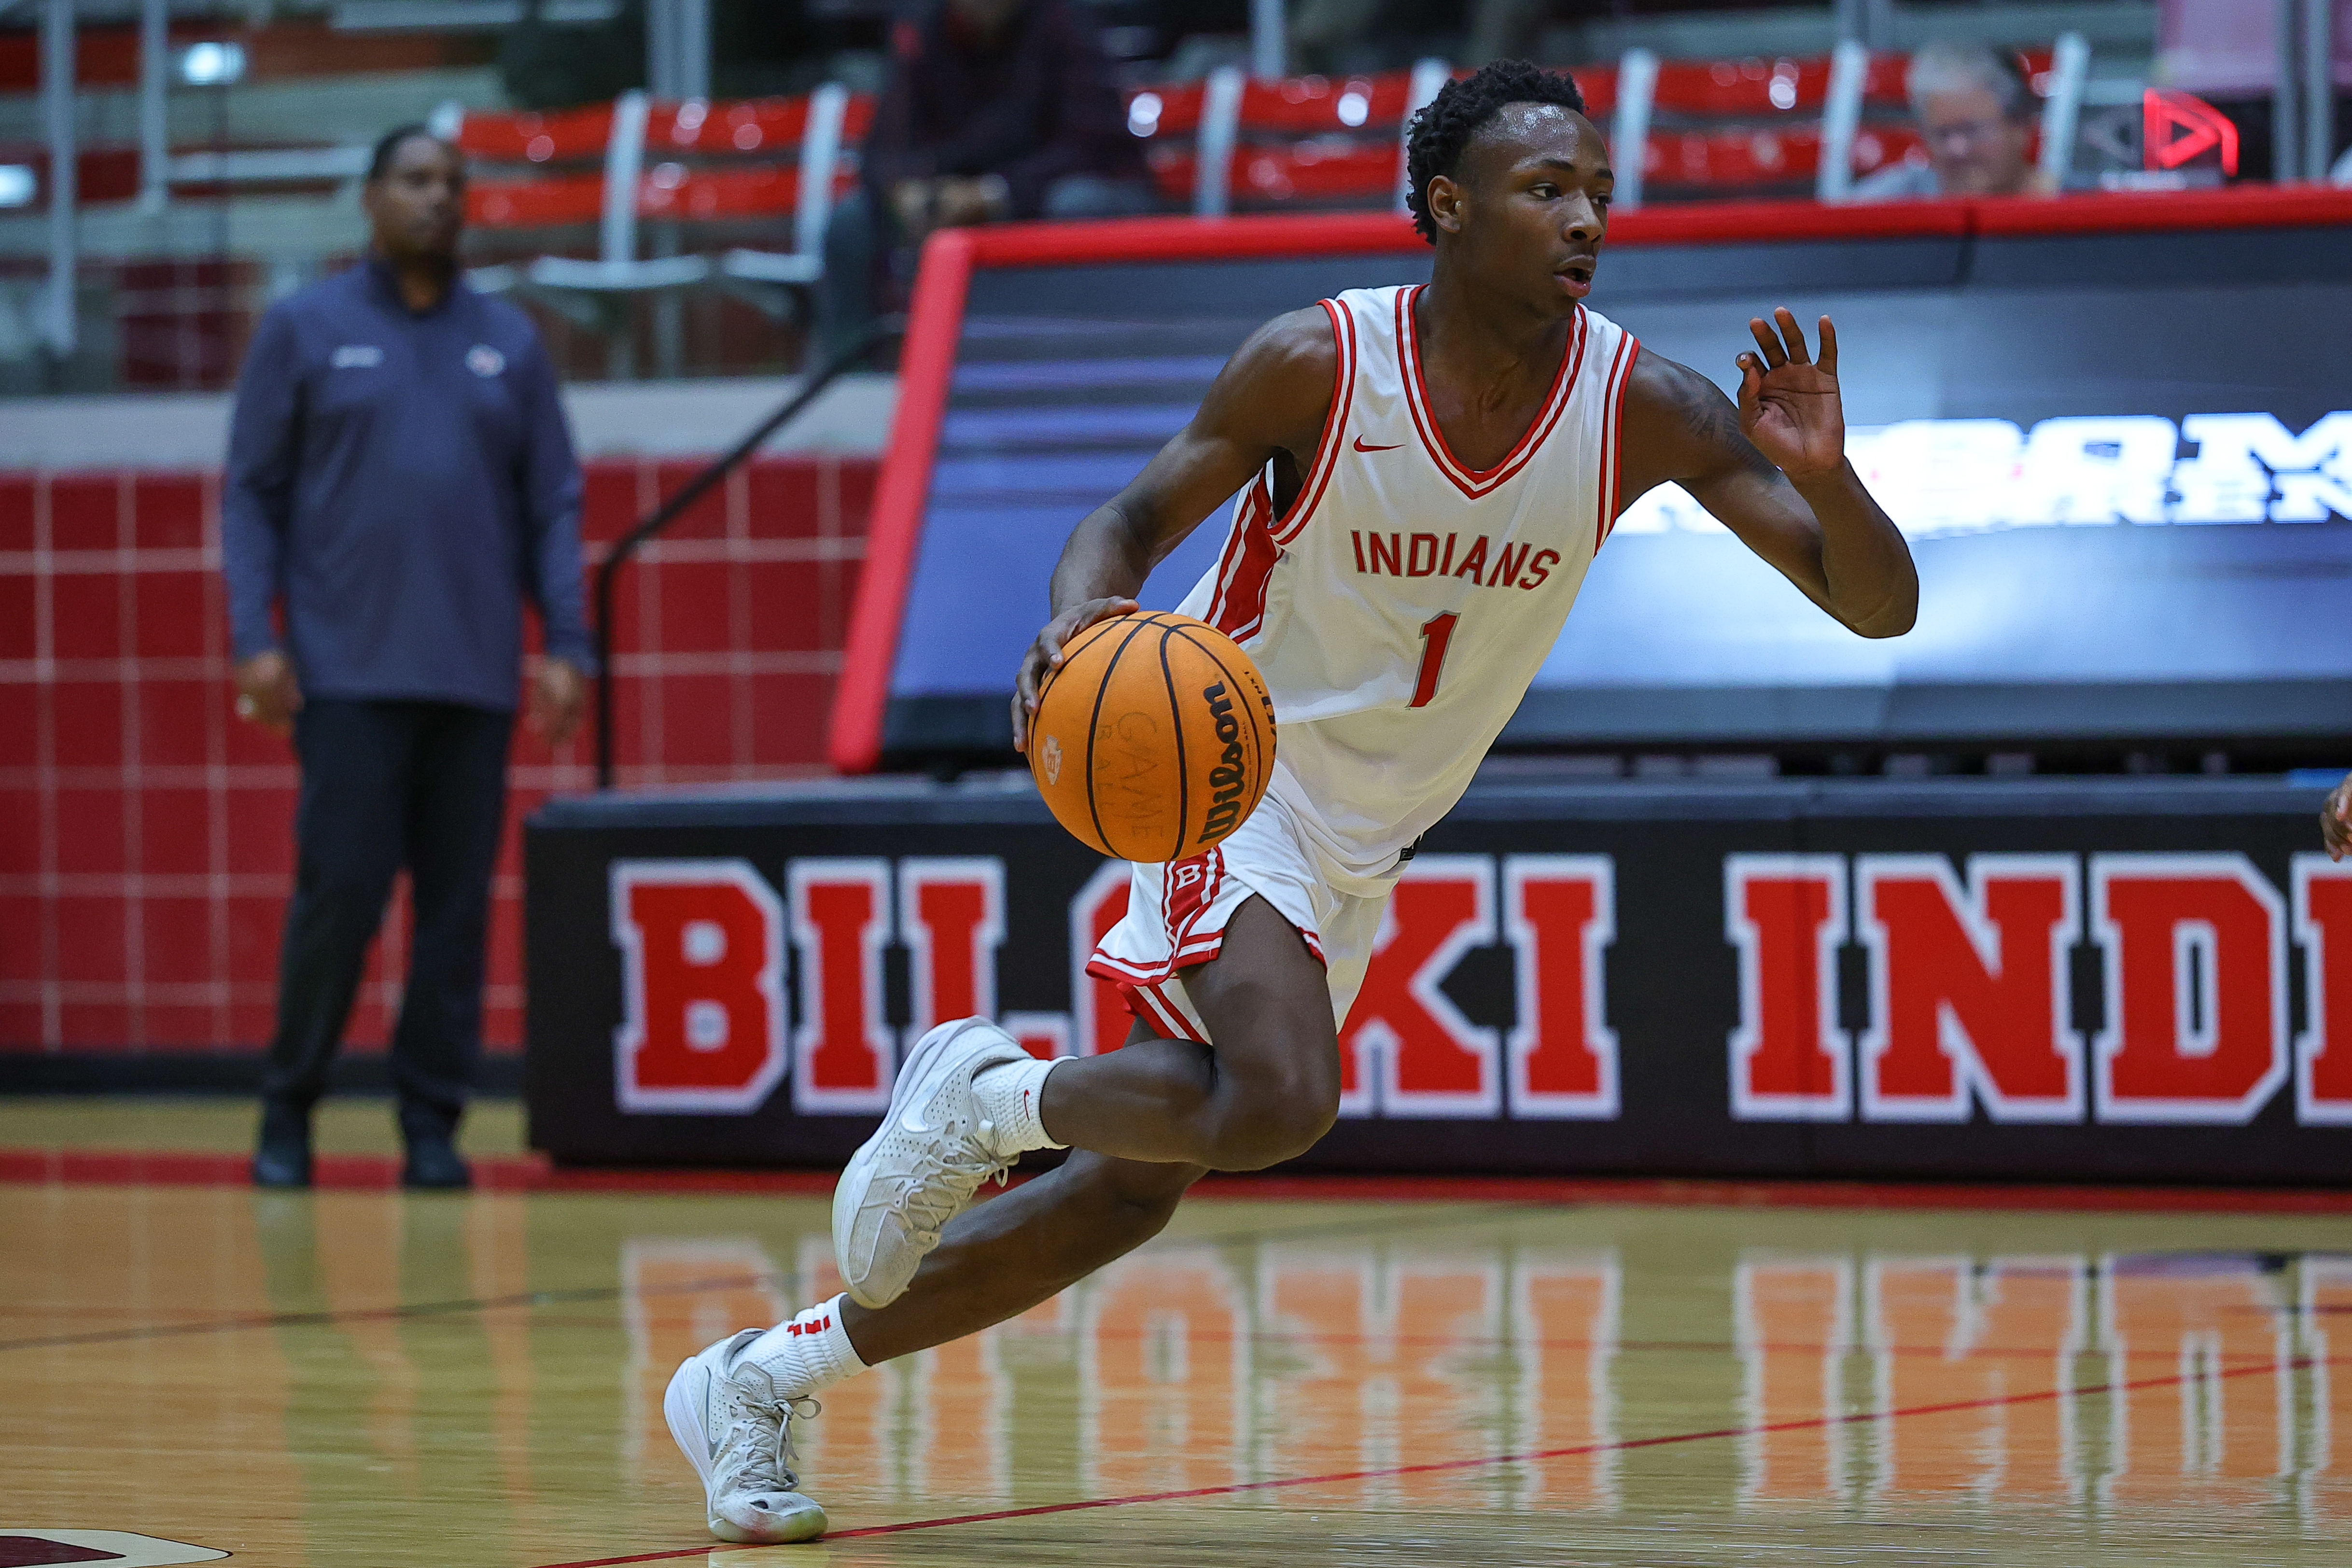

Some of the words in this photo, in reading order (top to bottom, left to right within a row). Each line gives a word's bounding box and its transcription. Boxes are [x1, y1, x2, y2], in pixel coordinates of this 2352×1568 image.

[1350, 530, 1561, 590] INDIANS
[1405, 610, 1461, 709] 1
[1197, 680, 1245, 844] Wilson
[1176, 864, 1201, 890] B
